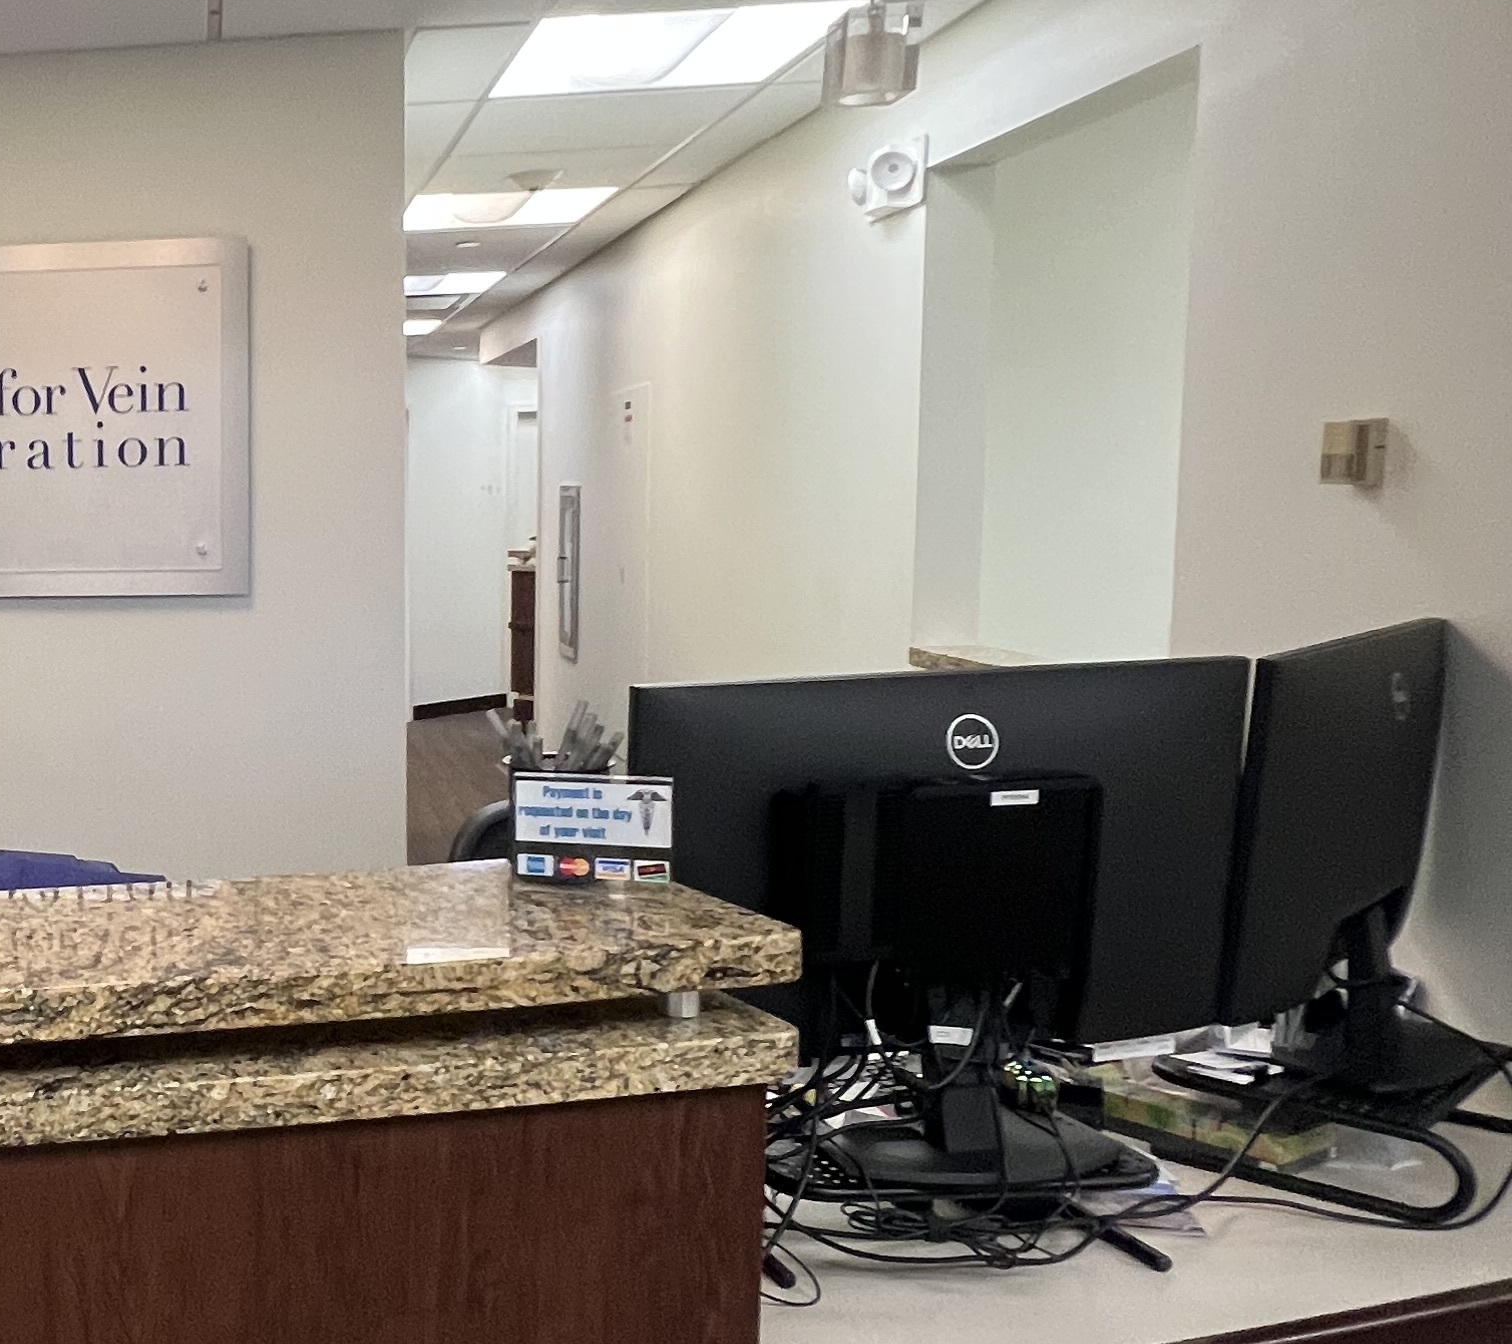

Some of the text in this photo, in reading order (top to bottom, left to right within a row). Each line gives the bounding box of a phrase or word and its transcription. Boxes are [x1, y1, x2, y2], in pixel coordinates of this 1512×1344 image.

[76, 365, 188, 414] Vein
[953, 733, 994, 749] DELL
[543, 786, 603, 800] Payment is
[592, 808, 609, 820] the
[613, 809, 633, 823] day
[554, 827, 579, 838] your
